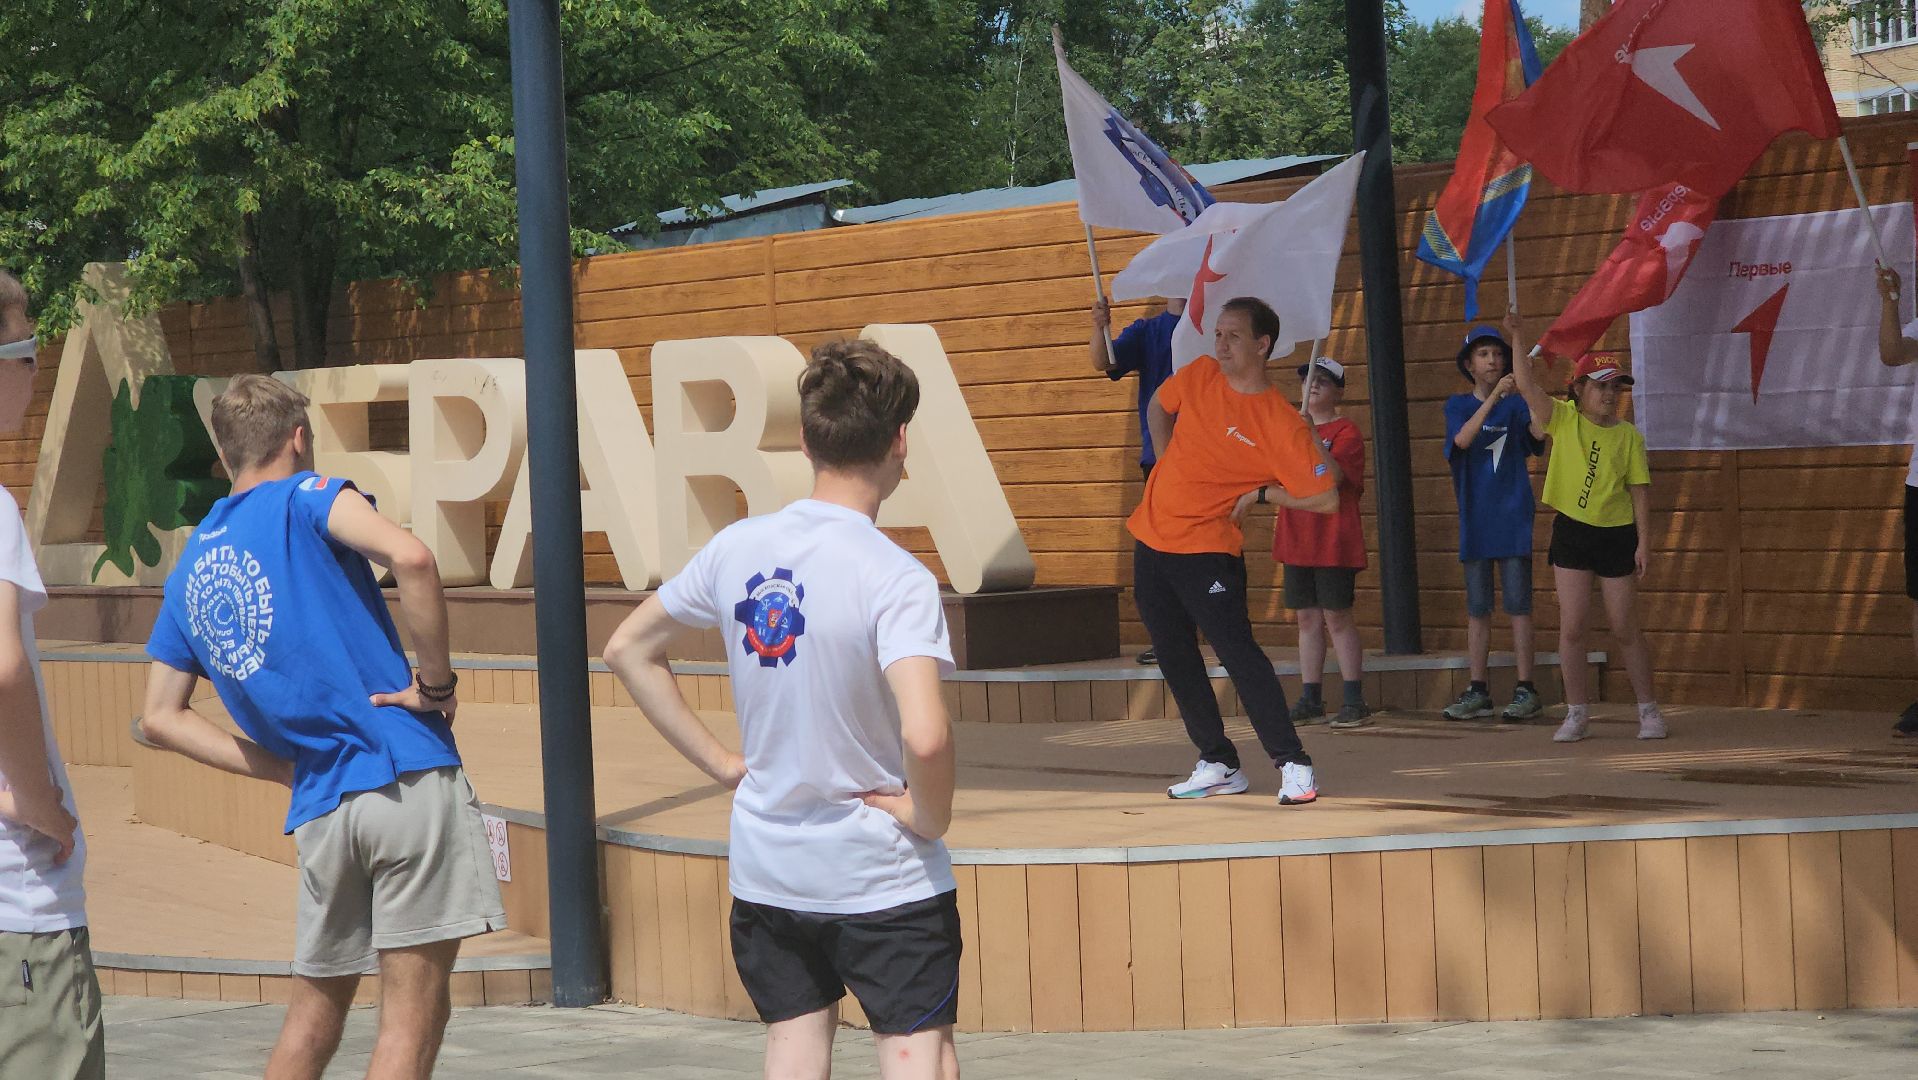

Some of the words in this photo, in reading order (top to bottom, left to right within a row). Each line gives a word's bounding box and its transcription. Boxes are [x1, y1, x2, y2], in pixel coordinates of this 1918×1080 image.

[1728, 259, 1793, 281] Первые
[25, 261, 1036, 594] ДБРАВА
[1578, 440, 1601, 510] JOMOTO
[241, 549, 261, 577] ТО
[254, 576, 274, 644] БЫТЬ
